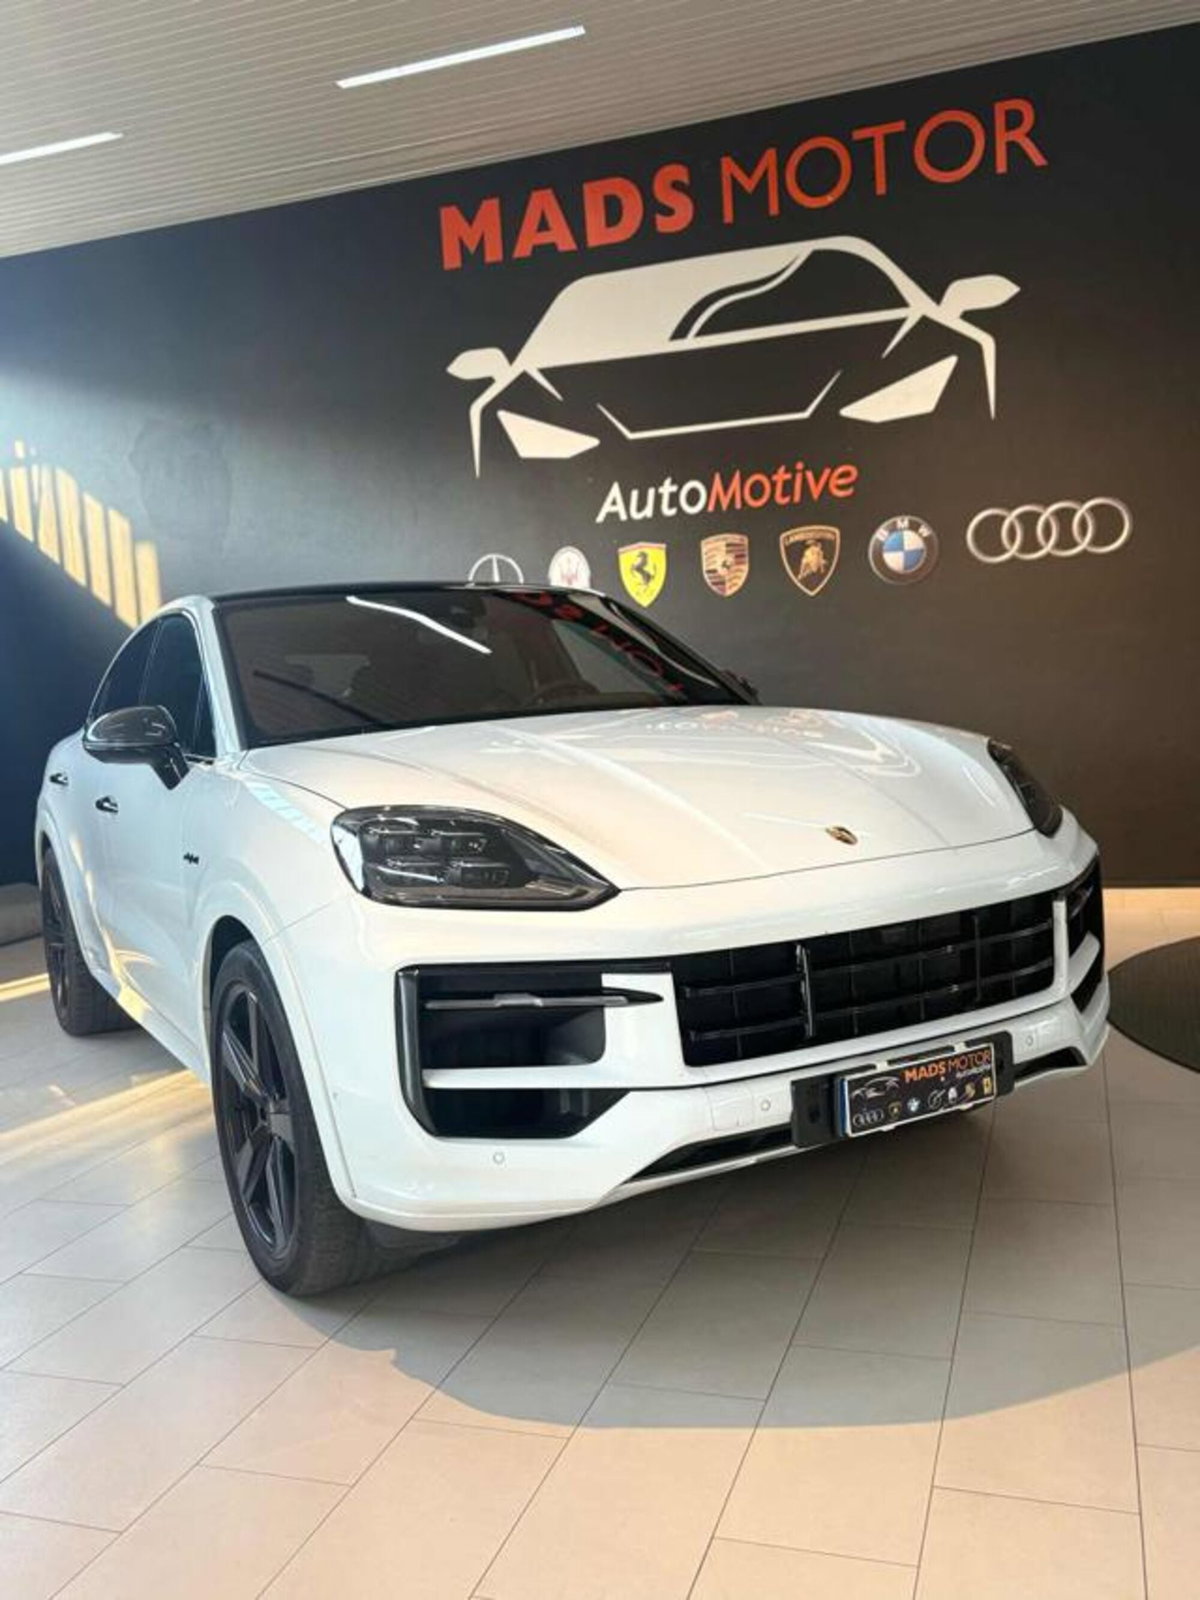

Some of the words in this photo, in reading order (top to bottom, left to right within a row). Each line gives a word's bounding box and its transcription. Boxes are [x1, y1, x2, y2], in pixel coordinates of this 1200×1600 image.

[439, 164, 694, 270] MADS
[719, 98, 1048, 225] MOTOR
[596, 461, 858, 523] AutoMotive
[905, 1060, 946, 1083] MADS
[948, 1050, 991, 1072] MOTOR
